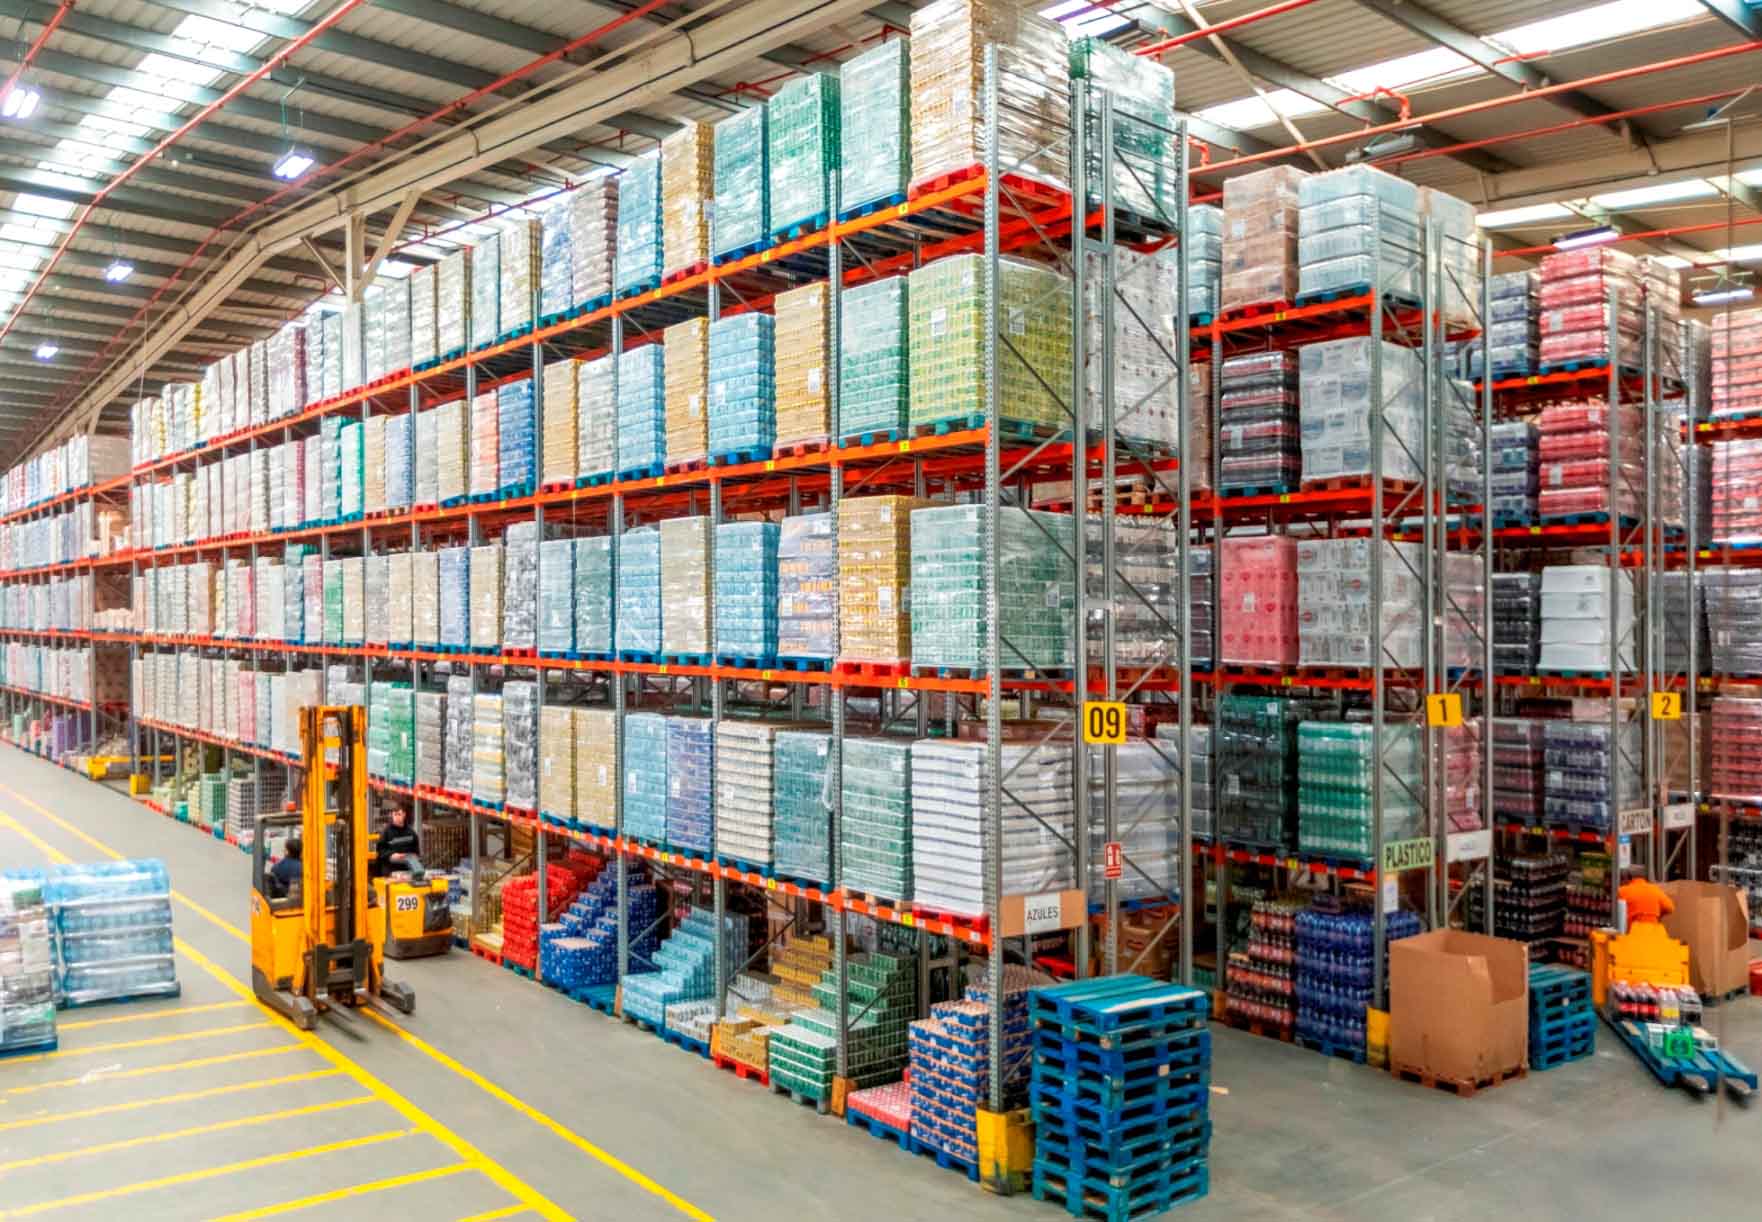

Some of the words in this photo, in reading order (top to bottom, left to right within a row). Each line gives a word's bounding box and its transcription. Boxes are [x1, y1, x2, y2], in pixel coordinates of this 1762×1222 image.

[1438, 699, 1448, 722] 1
[1661, 695, 1672, 715] 2
[1090, 706, 1120, 738] 09
[1386, 840, 1432, 868] PLASTICO
[397, 896, 418, 911] 299
[1026, 906, 1059, 921] AZULES
